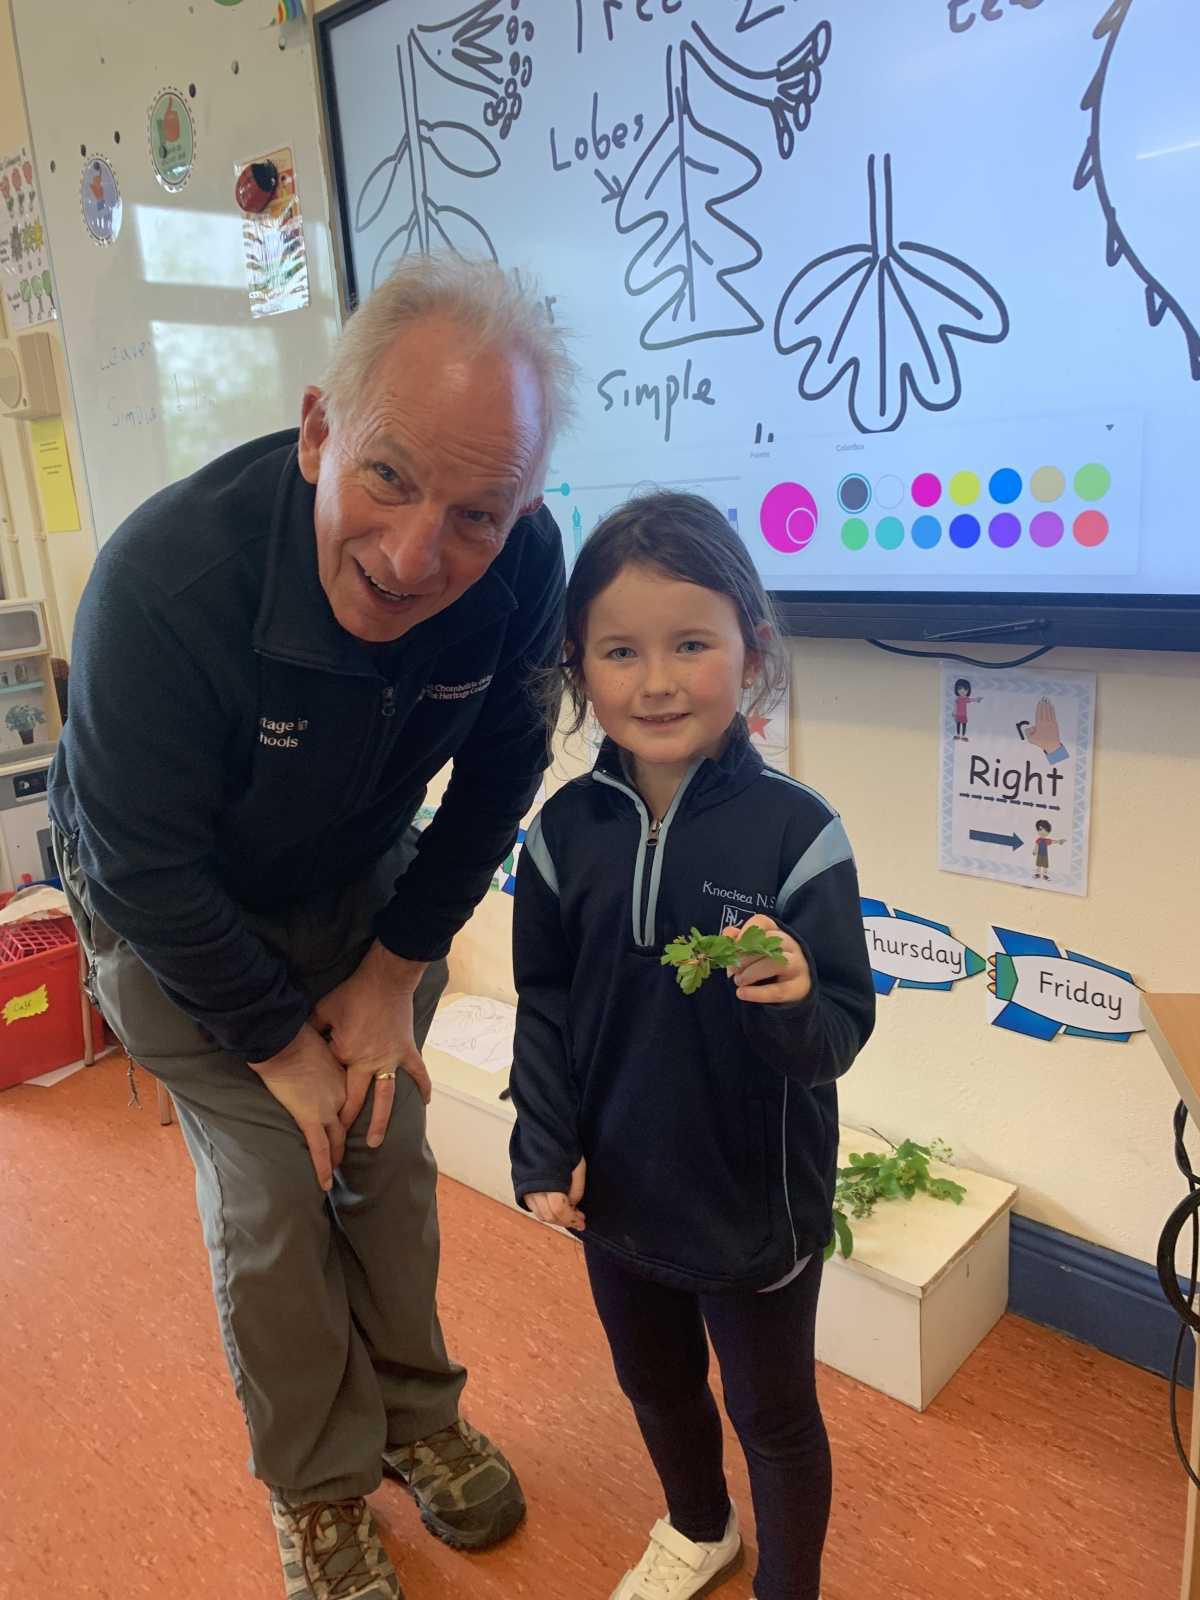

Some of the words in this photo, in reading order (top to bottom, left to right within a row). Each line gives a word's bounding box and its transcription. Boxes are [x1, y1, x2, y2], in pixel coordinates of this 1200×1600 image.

[549, 91, 644, 171] Lobes
[597, 358, 716, 443] Simple
[969, 755, 1064, 800] Right
[702, 880, 754, 905] Knockea
[1039, 971, 1123, 1021] Friday
